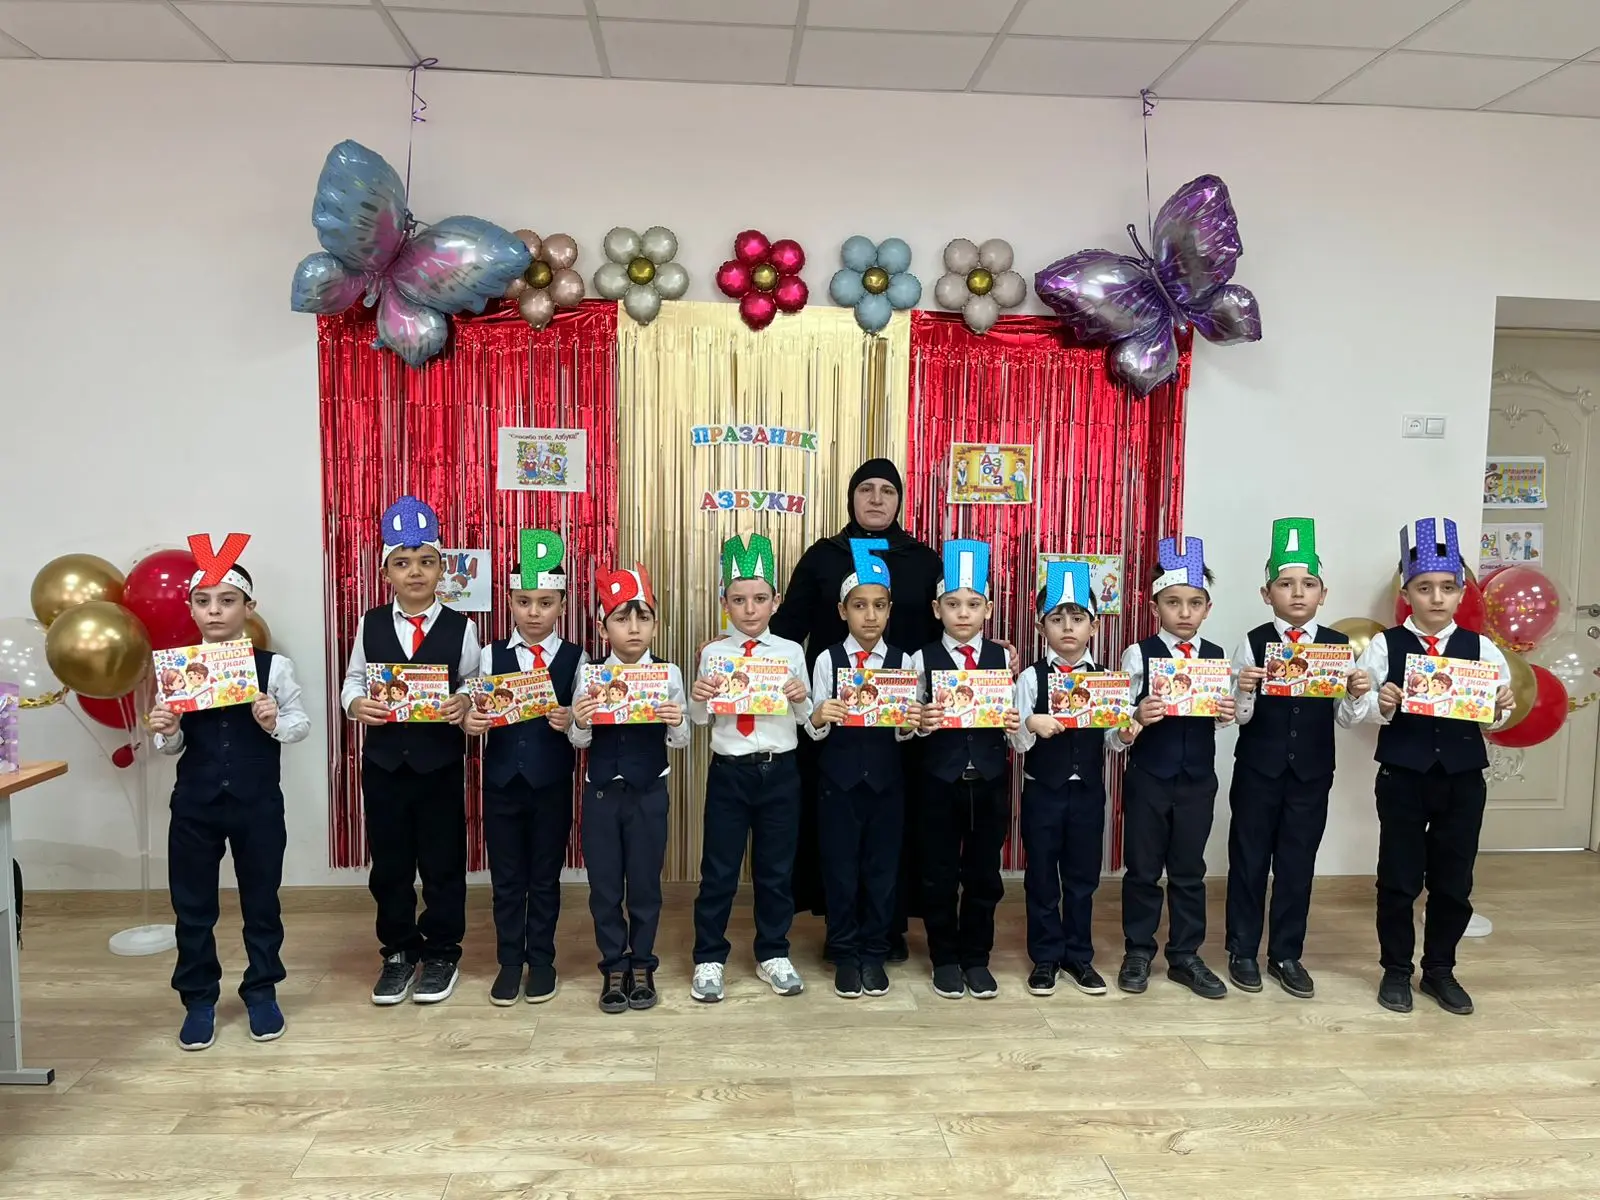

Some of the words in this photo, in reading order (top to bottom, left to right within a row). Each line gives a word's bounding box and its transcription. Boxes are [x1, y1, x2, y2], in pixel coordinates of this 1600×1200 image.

[692, 426, 816, 450] ПРАЗДНИК
[382, 496, 440, 548] Ф
[700, 491, 805, 514] АЗБУКИ
[187, 533, 252, 588] У
[520, 528, 564, 590] Р
[723, 533, 775, 590] М
[850, 538, 890, 588] Б
[944, 538, 991, 596] П
[1158, 536, 1204, 588] Ч
[1270, 518, 1318, 582] Д
[596, 560, 655, 616] Ы
[205, 649, 250, 662] ДИПЛОМ
[1454, 668, 1494, 679] ДИПЛОМ
